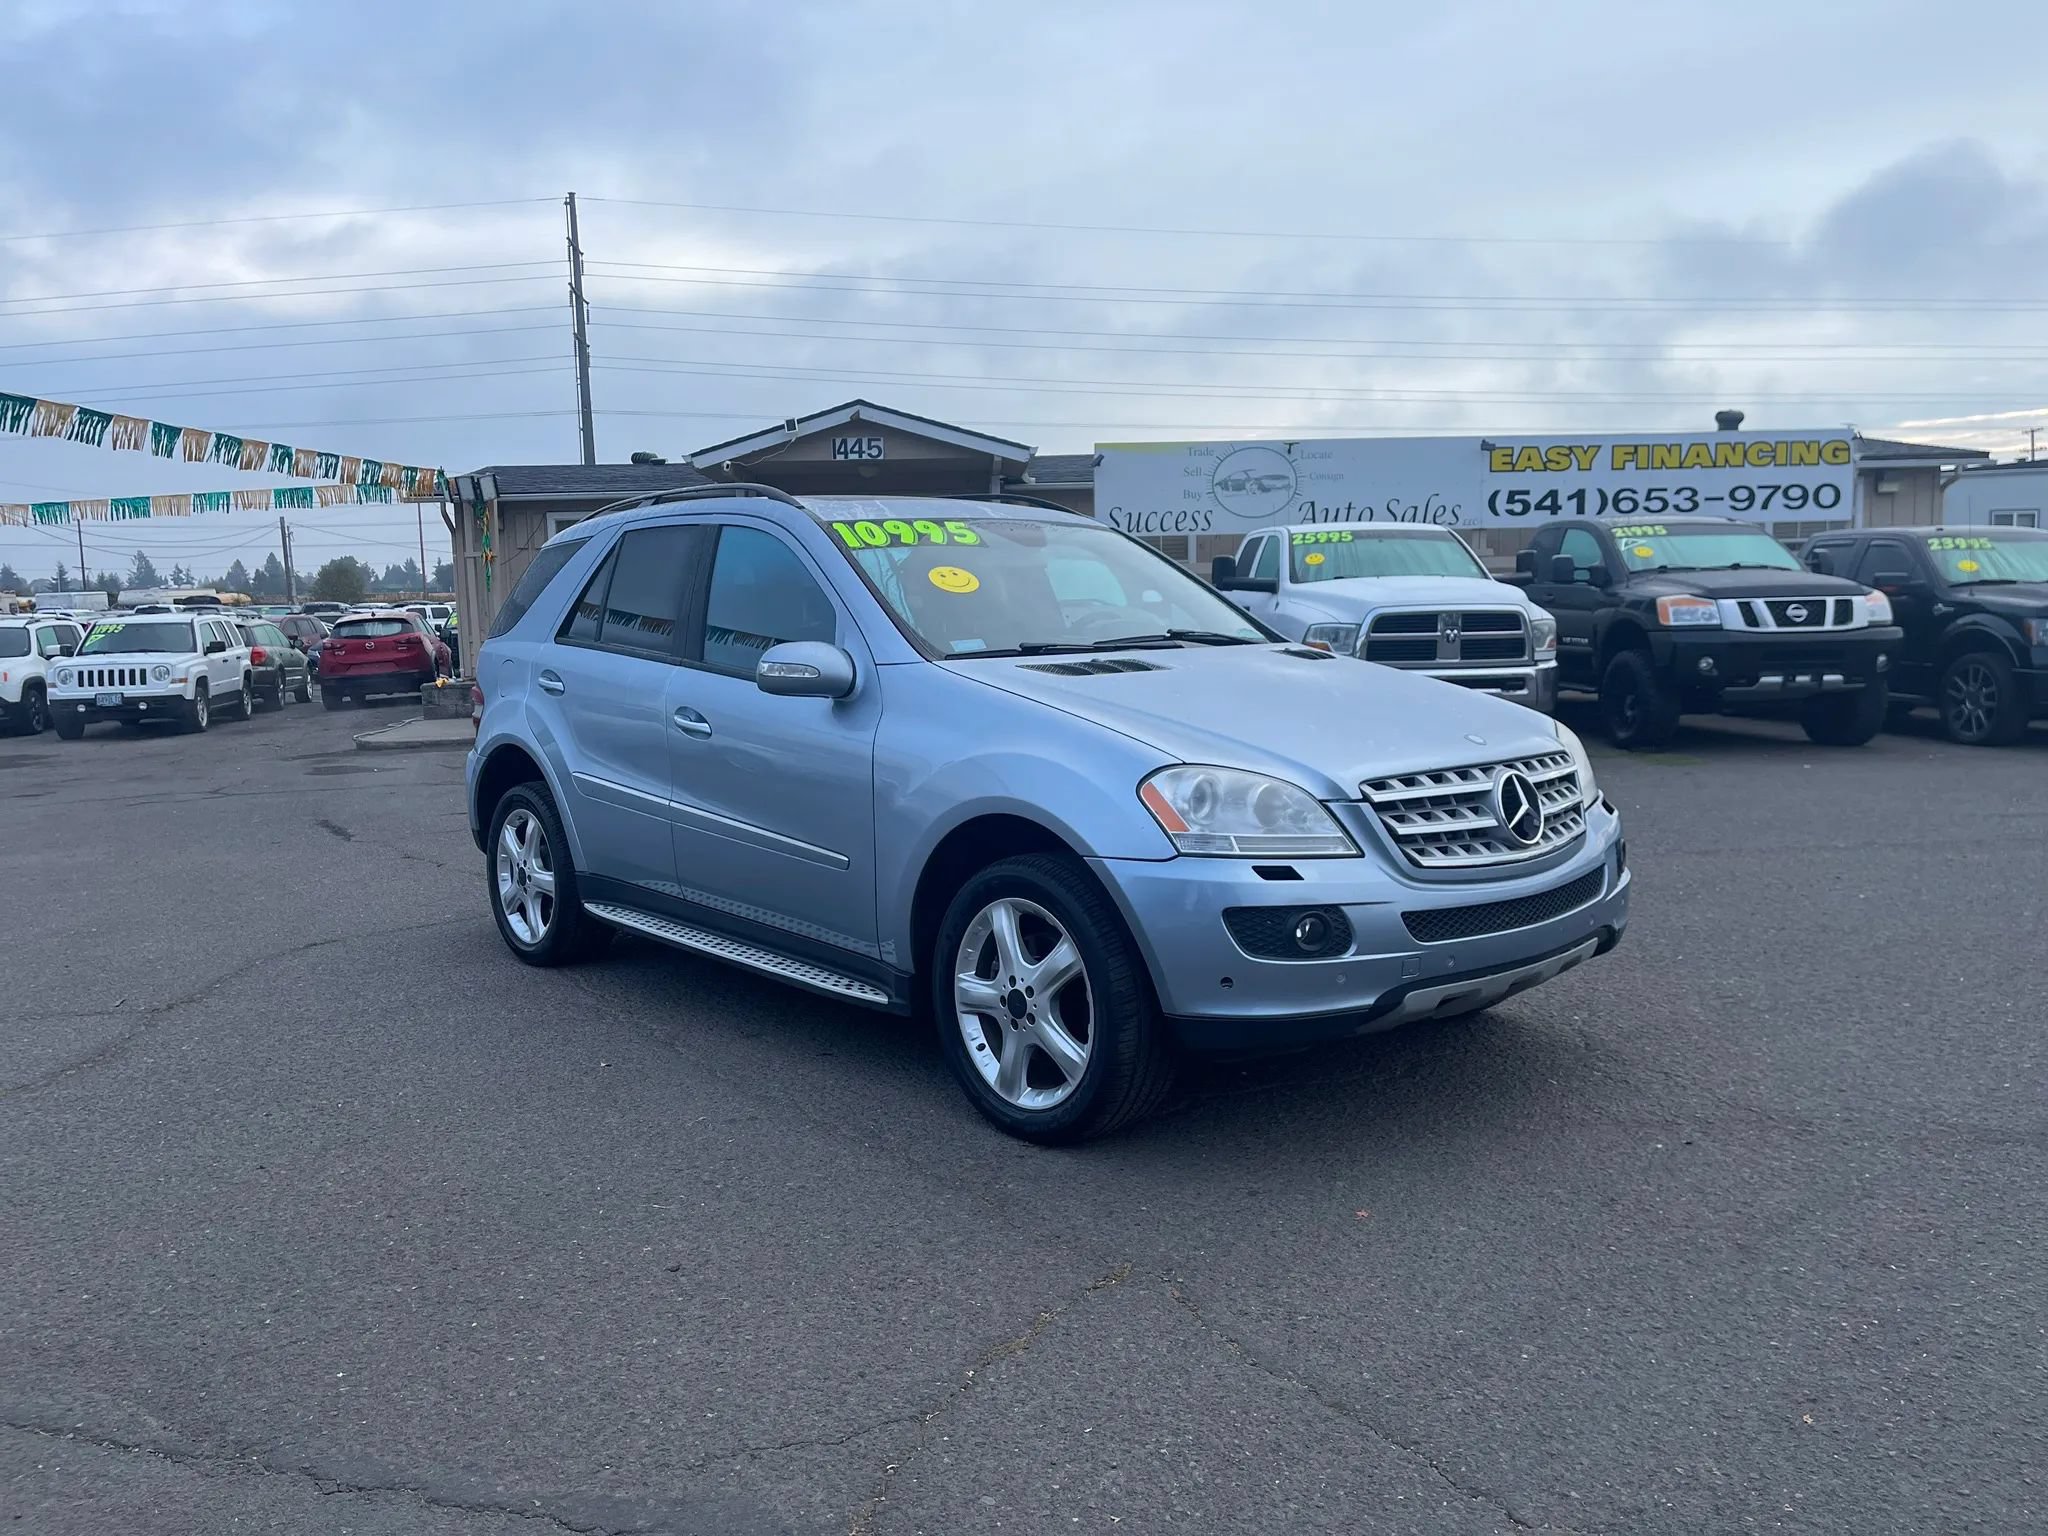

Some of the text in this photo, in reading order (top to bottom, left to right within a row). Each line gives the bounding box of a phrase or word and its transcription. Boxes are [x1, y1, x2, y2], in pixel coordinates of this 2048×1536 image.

[832, 437, 883, 460] 1445
[1187, 446, 1215, 458] Trade
[1300, 449, 1334, 460] Locate
[1489, 439, 1852, 473] EASY FINANCING
[1183, 467, 1202, 478] Sell
[1308, 471, 1345, 481] Consign
[1182, 488, 1202, 501] Buy
[1487, 482, 1842, 517] (541)653-9790
[1107, 506, 1214, 533] Success
[1297, 499, 1375, 524] Auto
[1385, 493, 1463, 526] Sales
[832, 519, 981, 549] 10995
[1291, 530, 1354, 545] 25995
[1610, 525, 1668, 538] 21995
